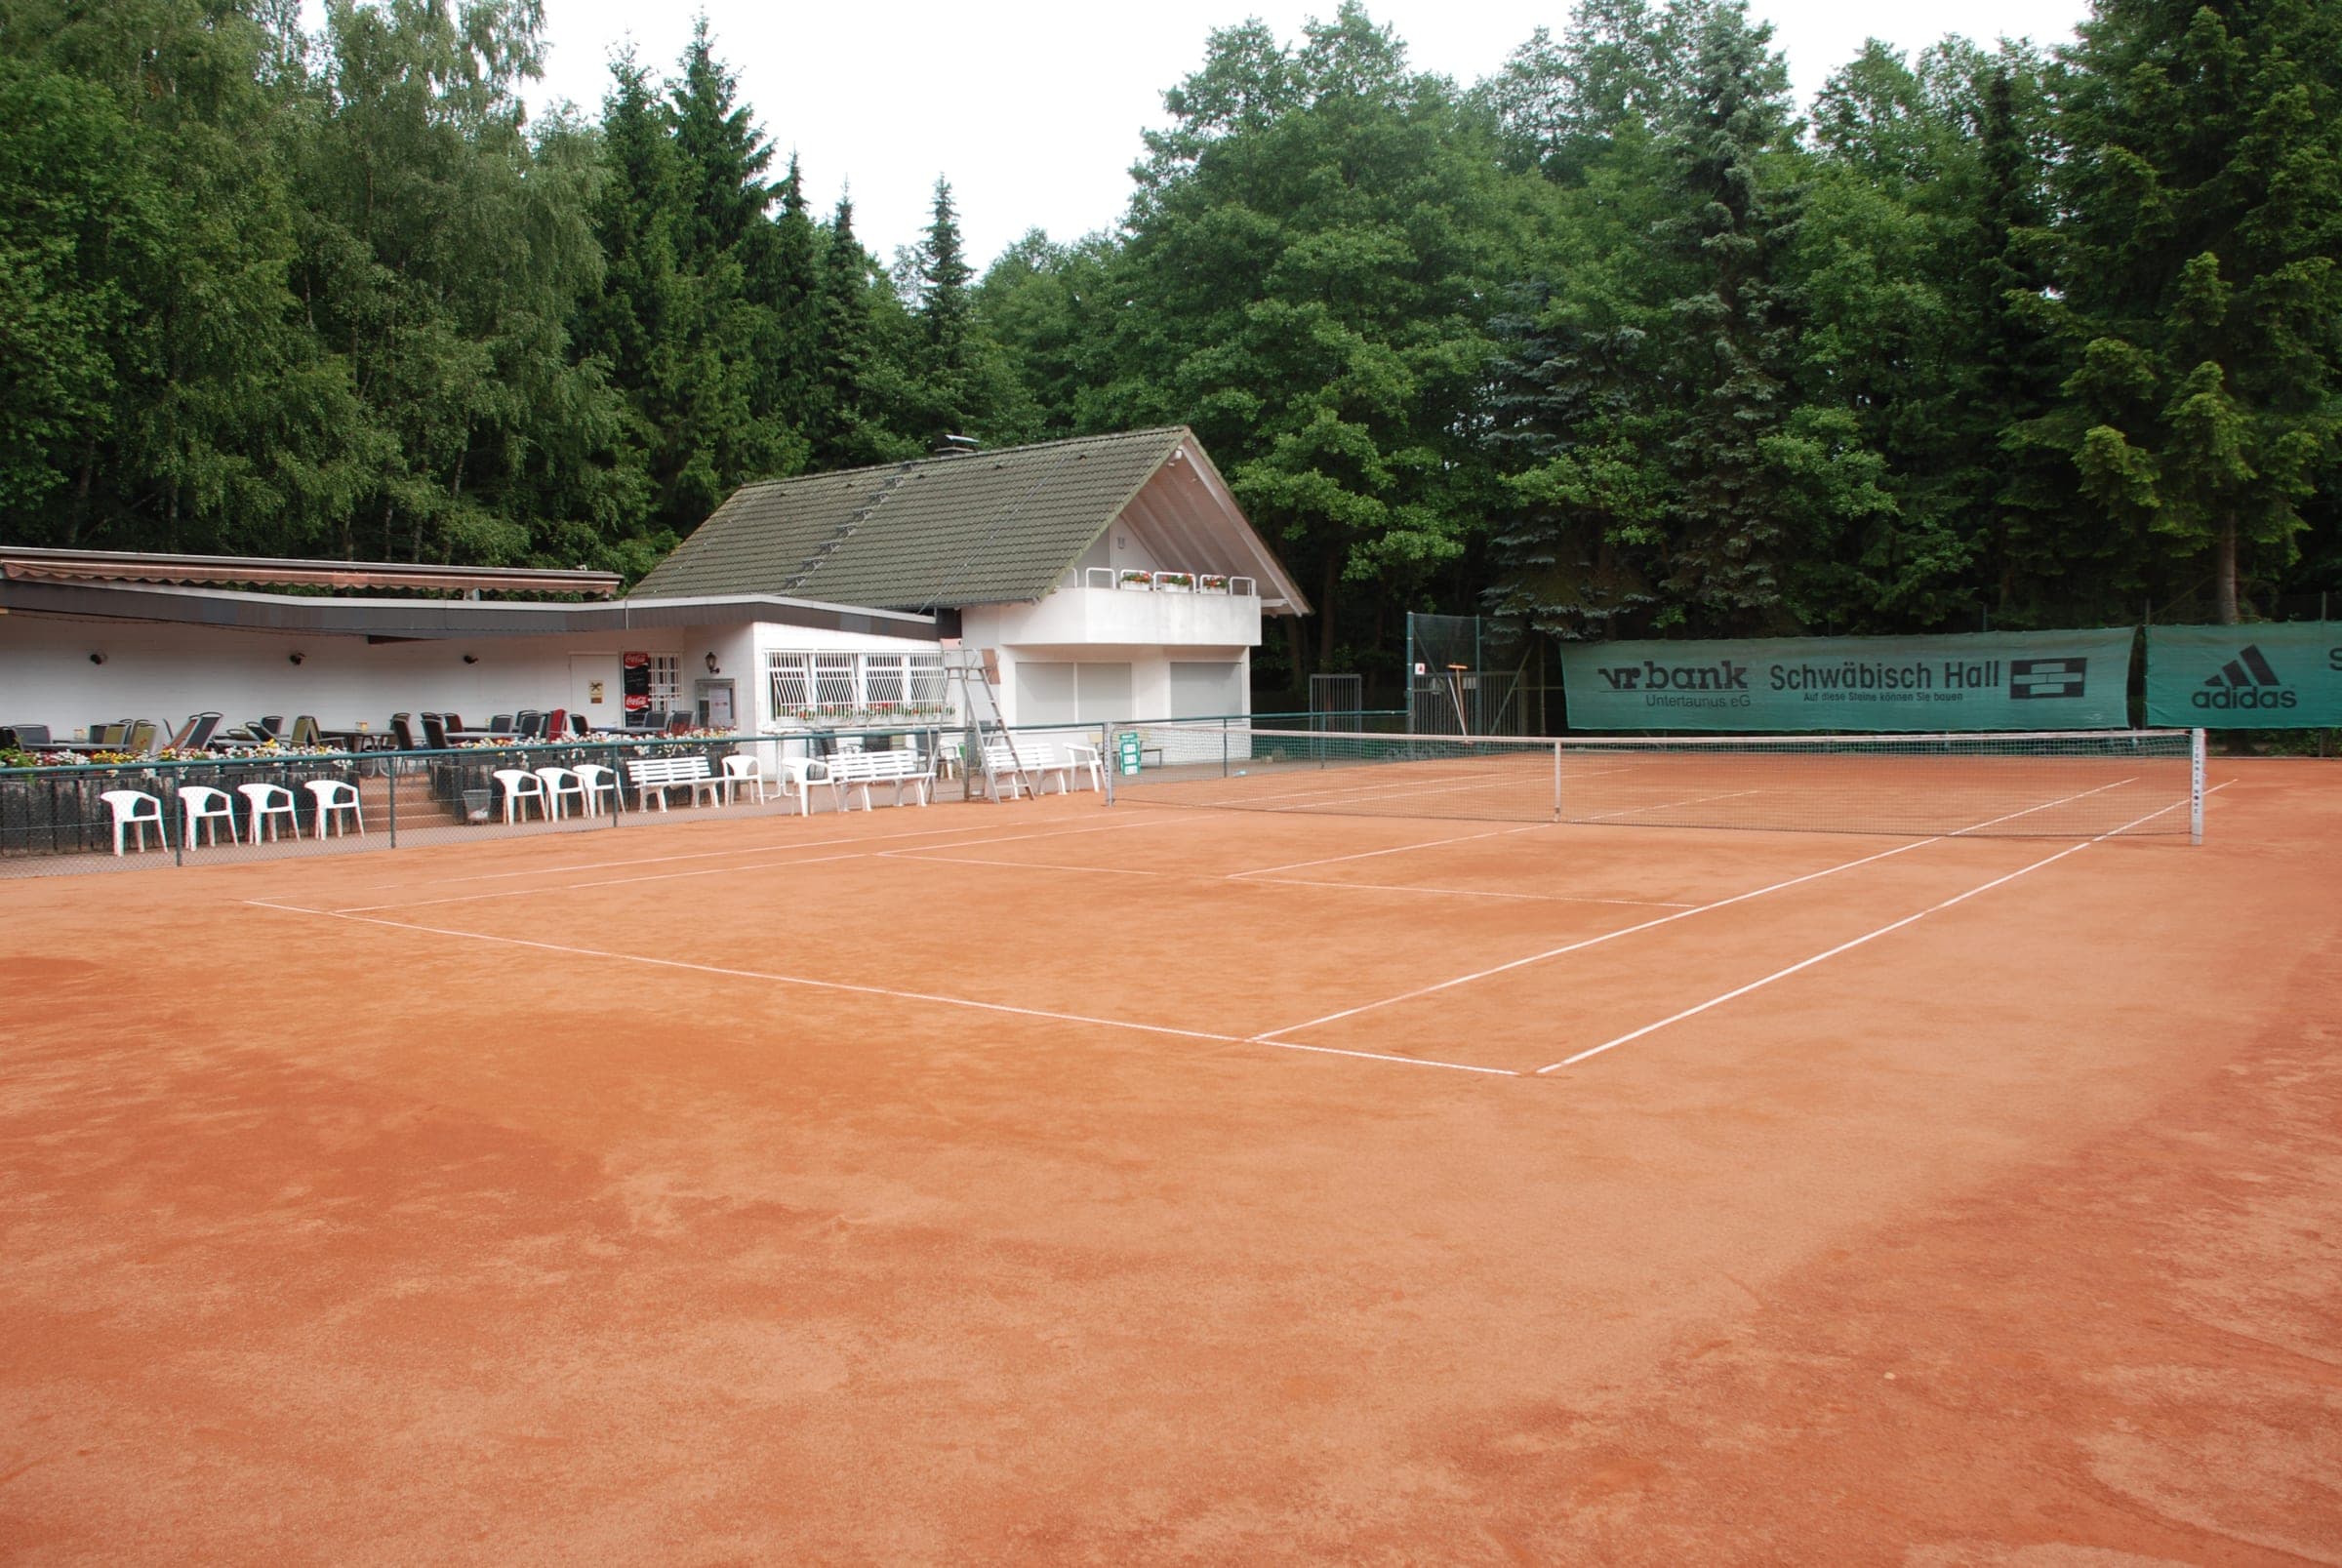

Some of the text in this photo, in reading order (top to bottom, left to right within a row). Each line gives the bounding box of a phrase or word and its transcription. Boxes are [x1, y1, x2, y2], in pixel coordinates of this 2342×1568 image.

[1769, 661, 1999, 691] Schwäbisch Hall
[1646, 694, 1751, 708] Untertaunus eG
[1803, 692, 1963, 702] Auf diese Steine können Sie bauen
[2191, 686, 2298, 709] adidas
